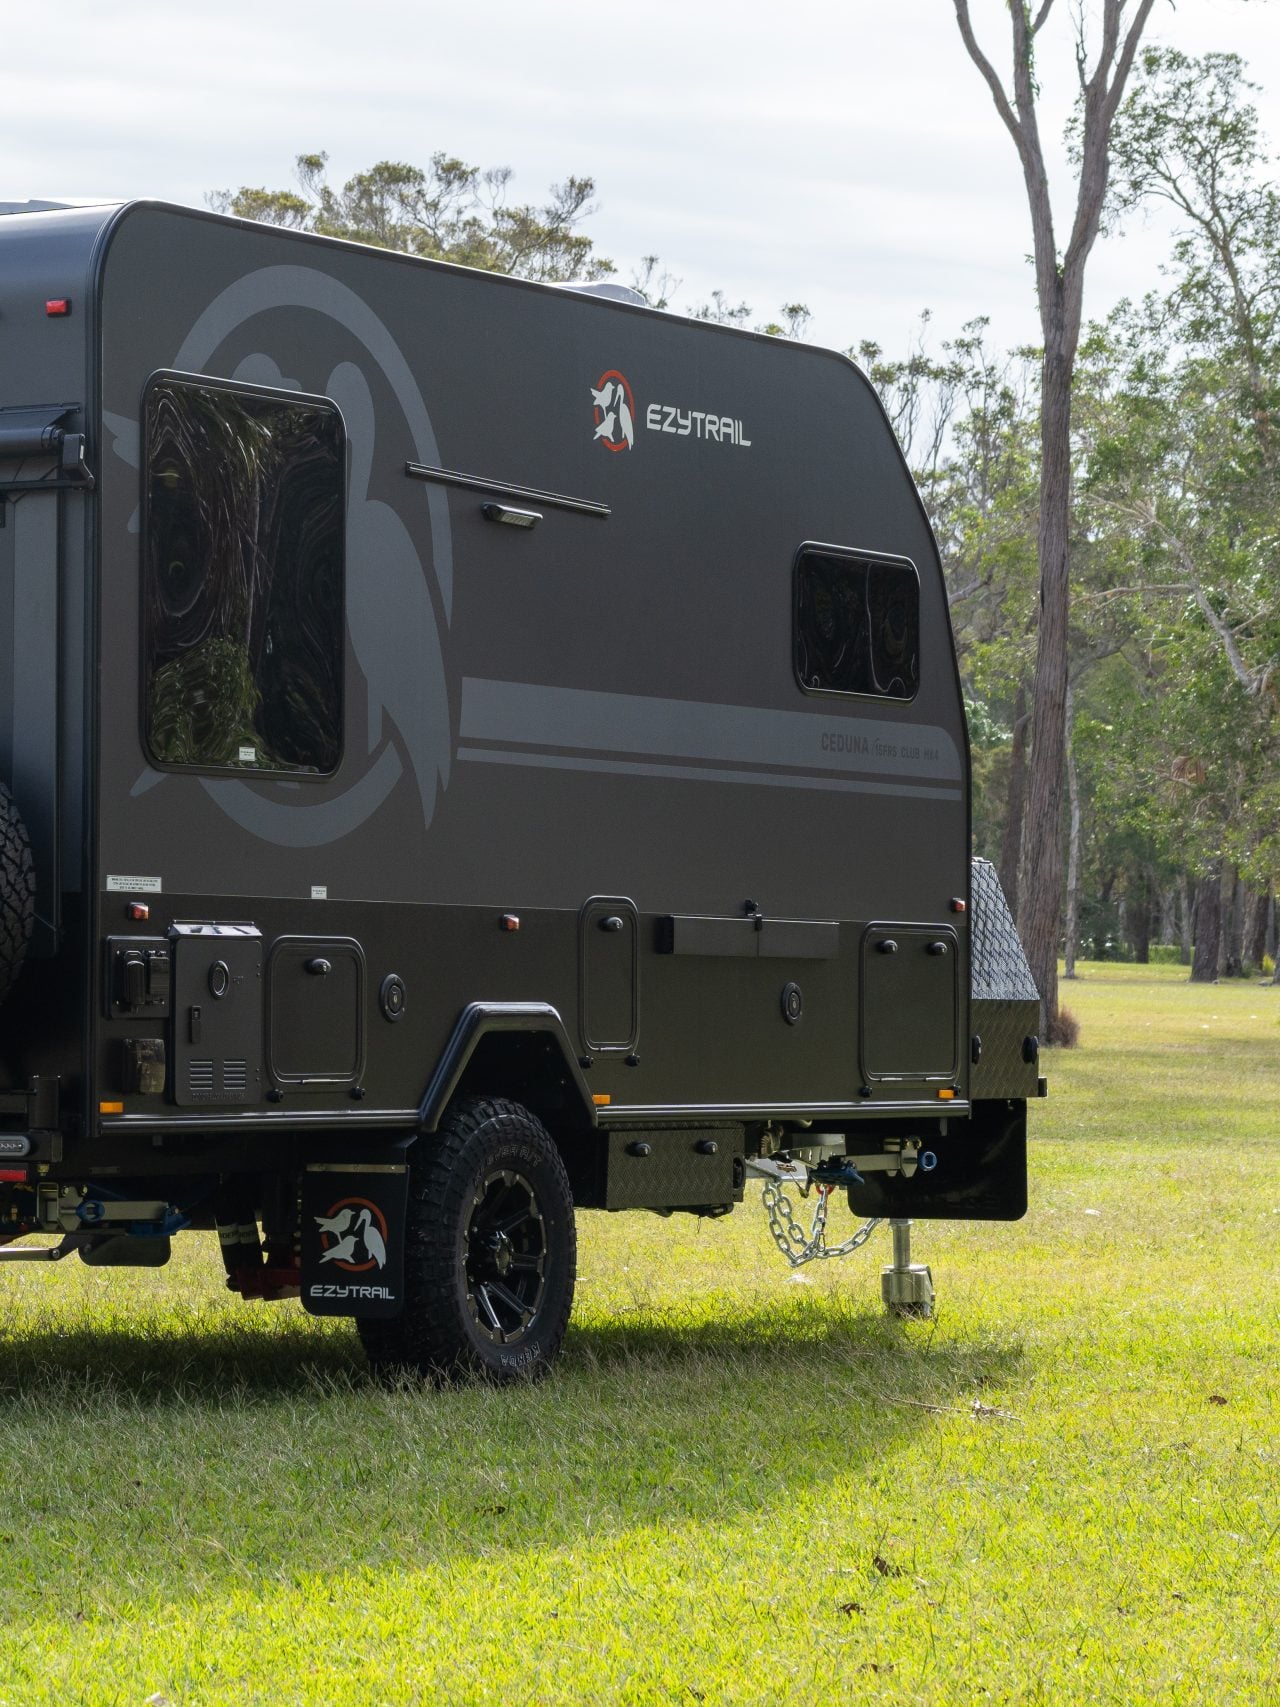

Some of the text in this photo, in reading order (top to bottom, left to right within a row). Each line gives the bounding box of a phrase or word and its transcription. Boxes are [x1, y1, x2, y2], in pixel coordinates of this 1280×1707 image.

[647, 404, 751, 446] EZYTRAIL
[821, 732, 869, 754] CEDUNA
[901, 746, 920, 759] CLUB
[310, 1284, 395, 1299] EZYTRAIL
[500, 1341, 541, 1367] KENDA
